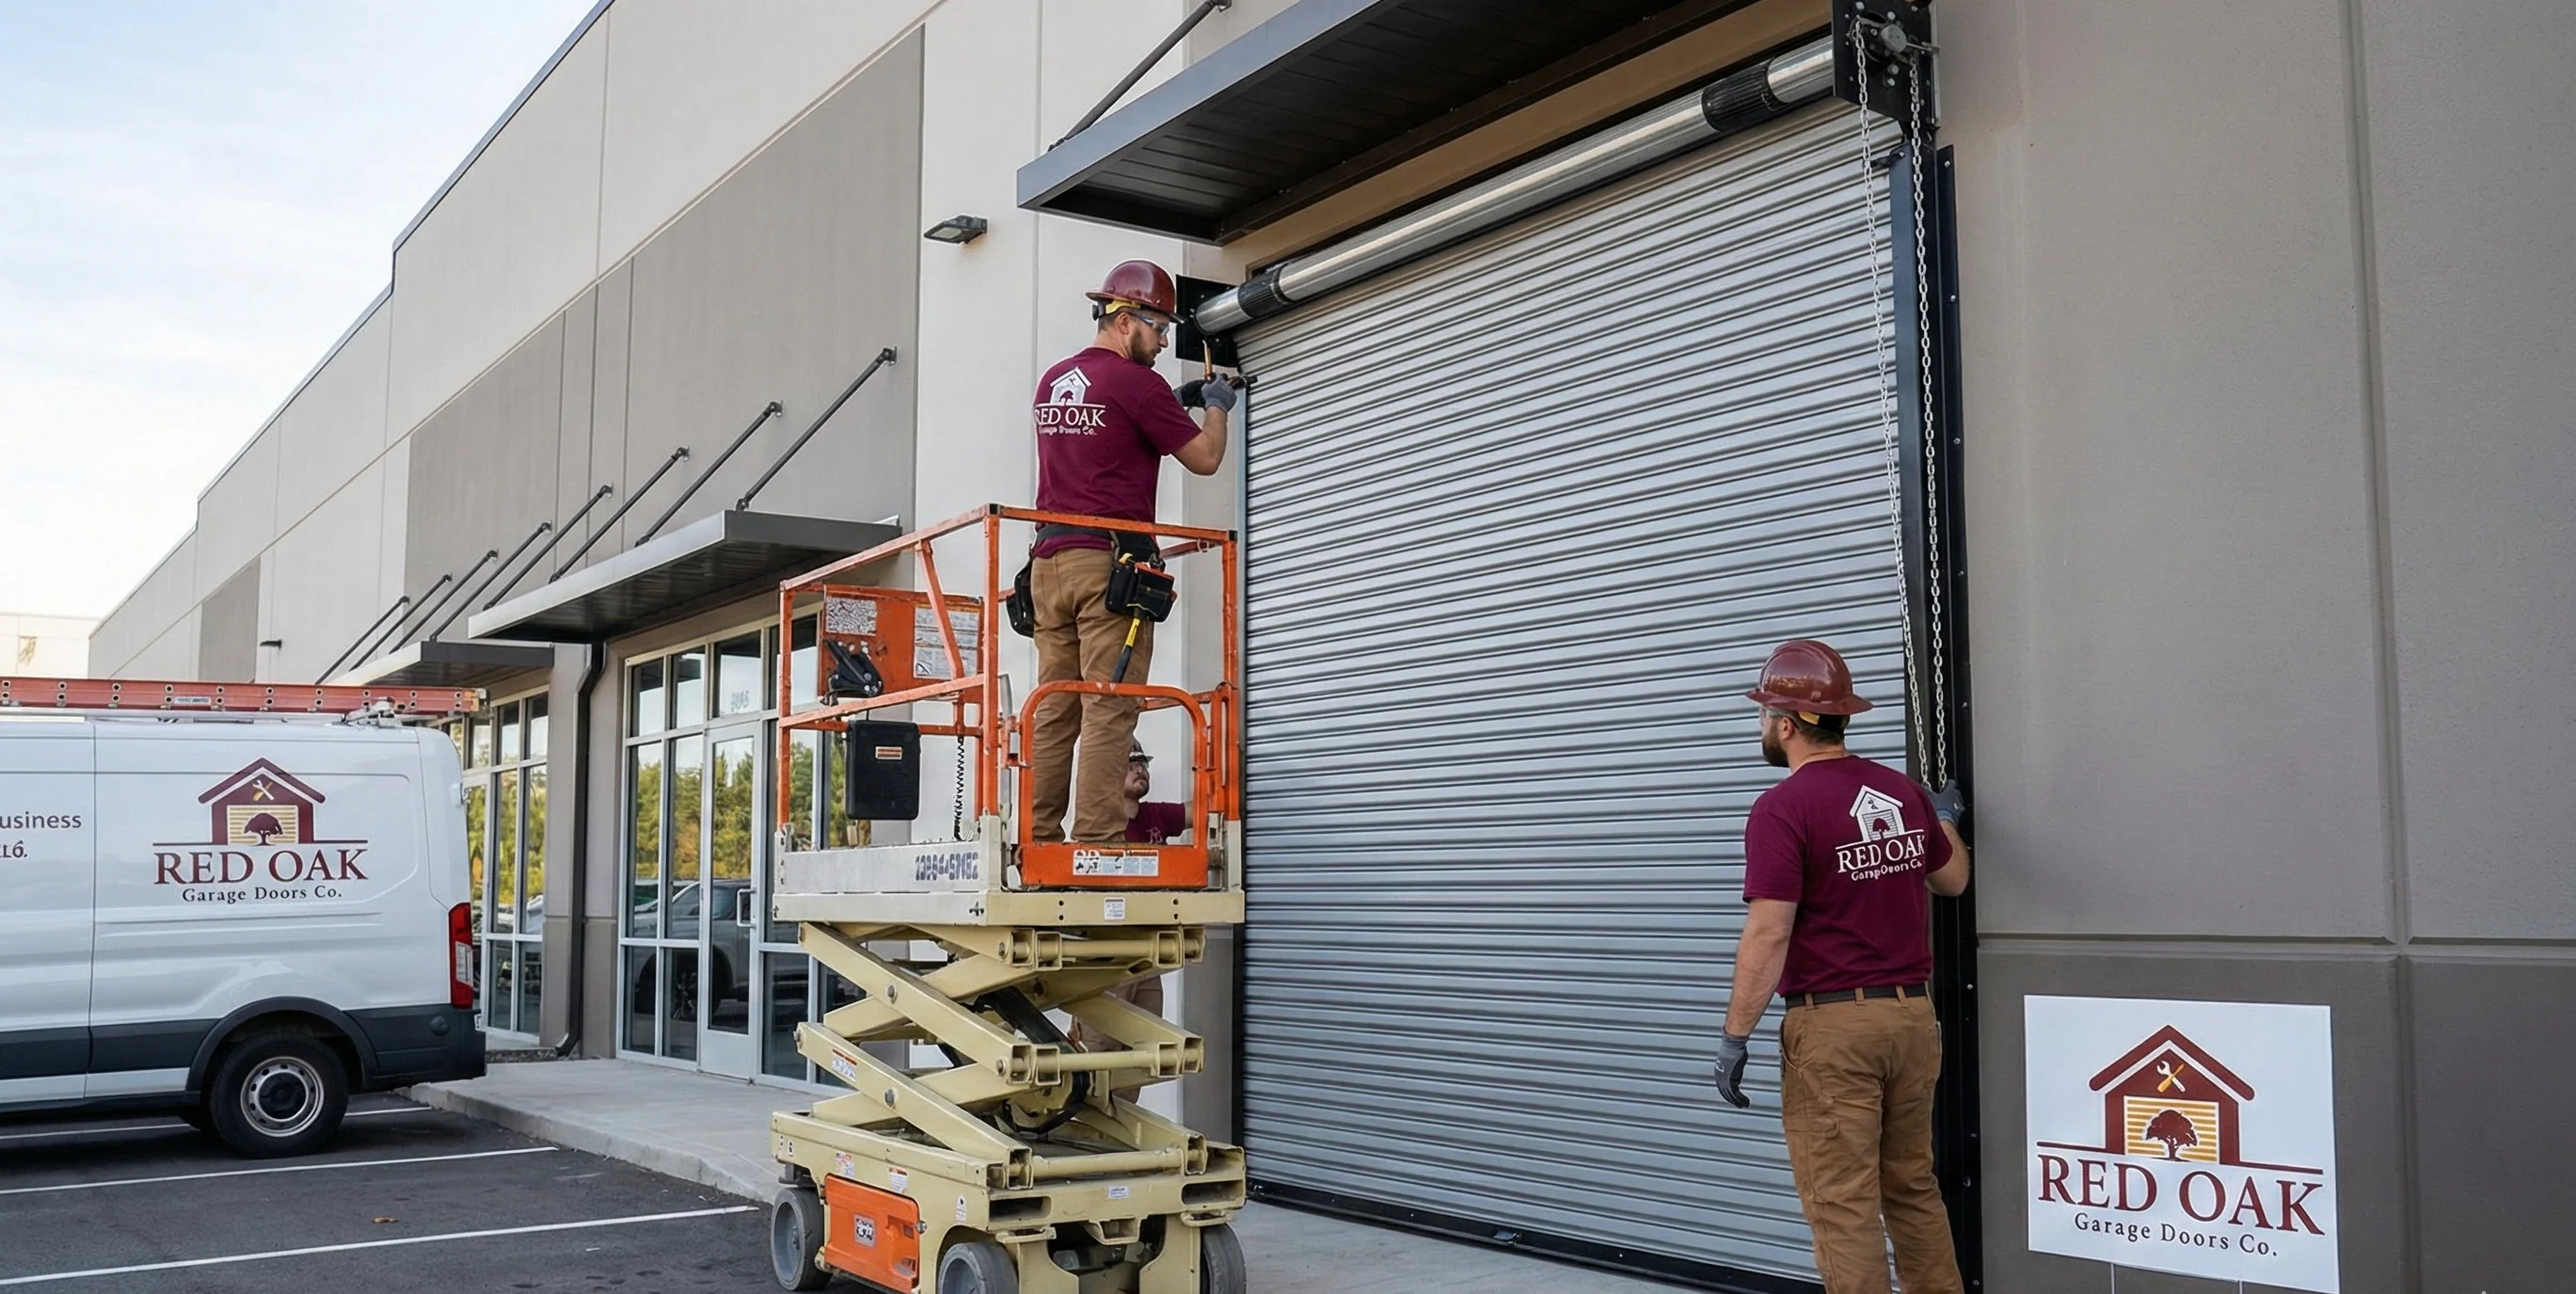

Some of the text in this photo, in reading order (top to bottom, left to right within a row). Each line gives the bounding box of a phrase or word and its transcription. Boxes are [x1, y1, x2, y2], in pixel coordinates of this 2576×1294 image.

[1065, 407, 1106, 427] OAK
[153, 849, 369, 885] RED OAK
[1837, 835, 1925, 873] RED OAK
[182, 885, 342, 904] Garage Doors Co.
[2037, 1154, 2326, 1236] RED OAK
[2075, 1212, 2278, 1256] Garage Doors Co.
